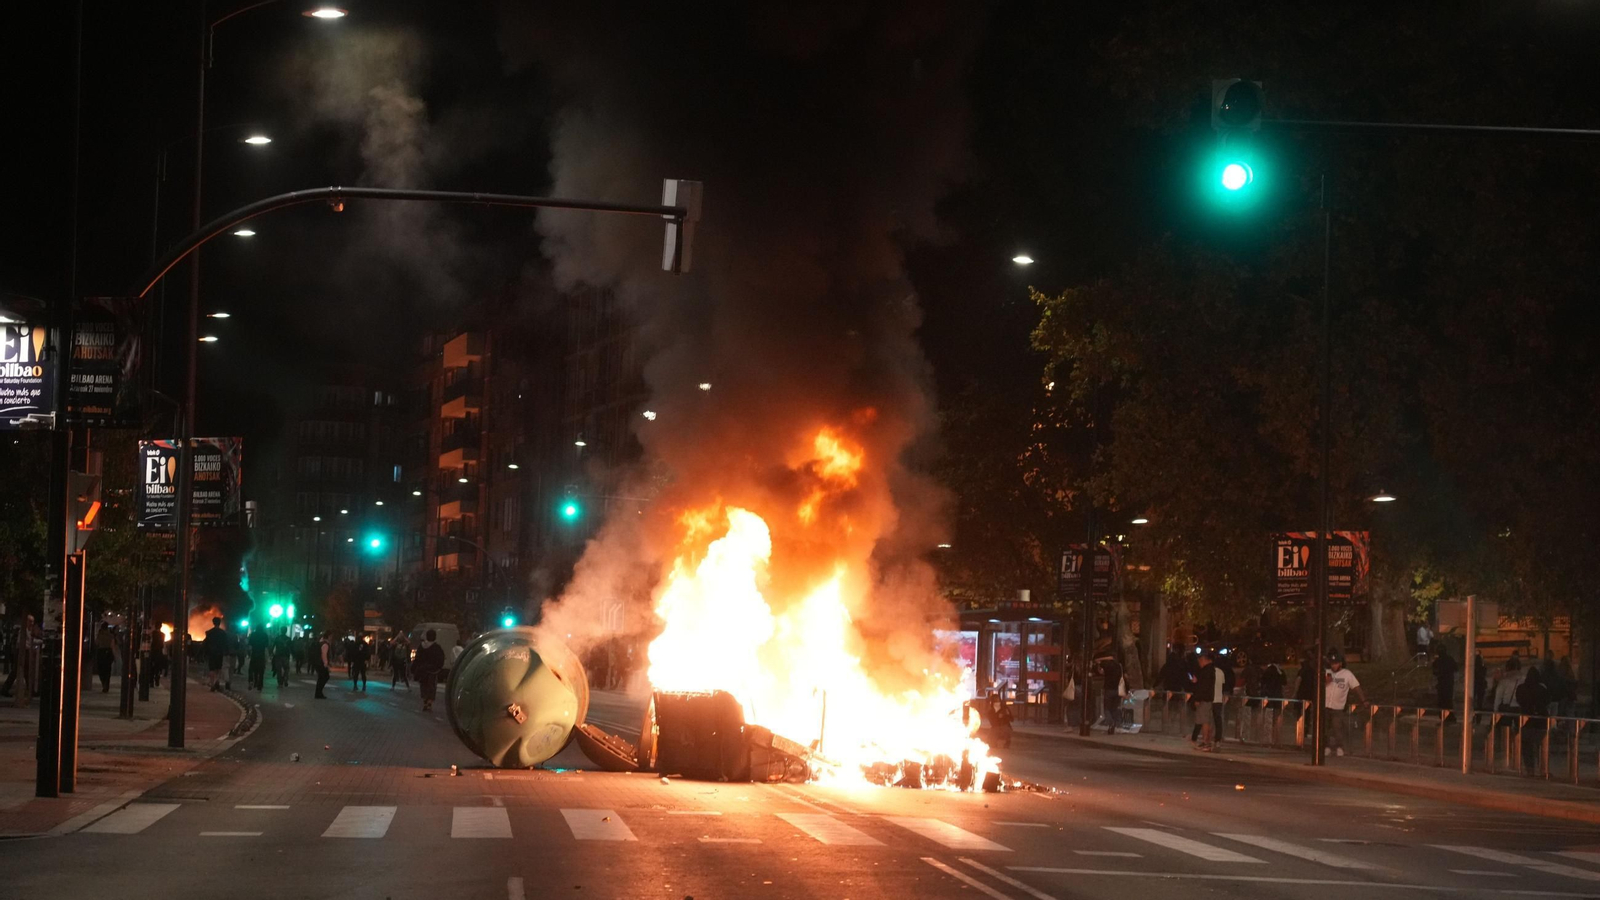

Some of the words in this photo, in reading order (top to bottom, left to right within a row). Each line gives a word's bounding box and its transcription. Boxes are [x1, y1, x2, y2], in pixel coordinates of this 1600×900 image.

[75, 332, 115, 345] BIZKAIKO
[73, 346, 114, 359] AHOTSAK
[70, 374, 95, 383] BILBAO
[95, 375, 113, 384] ARENA
[4, 396, 31, 404] concierto
[194, 462, 221, 471] BIZKAIKO
[193, 472, 221, 481] AHOTSAK
[146, 484, 175, 494] bilbao
[1278, 569, 1308, 577] bilbao
